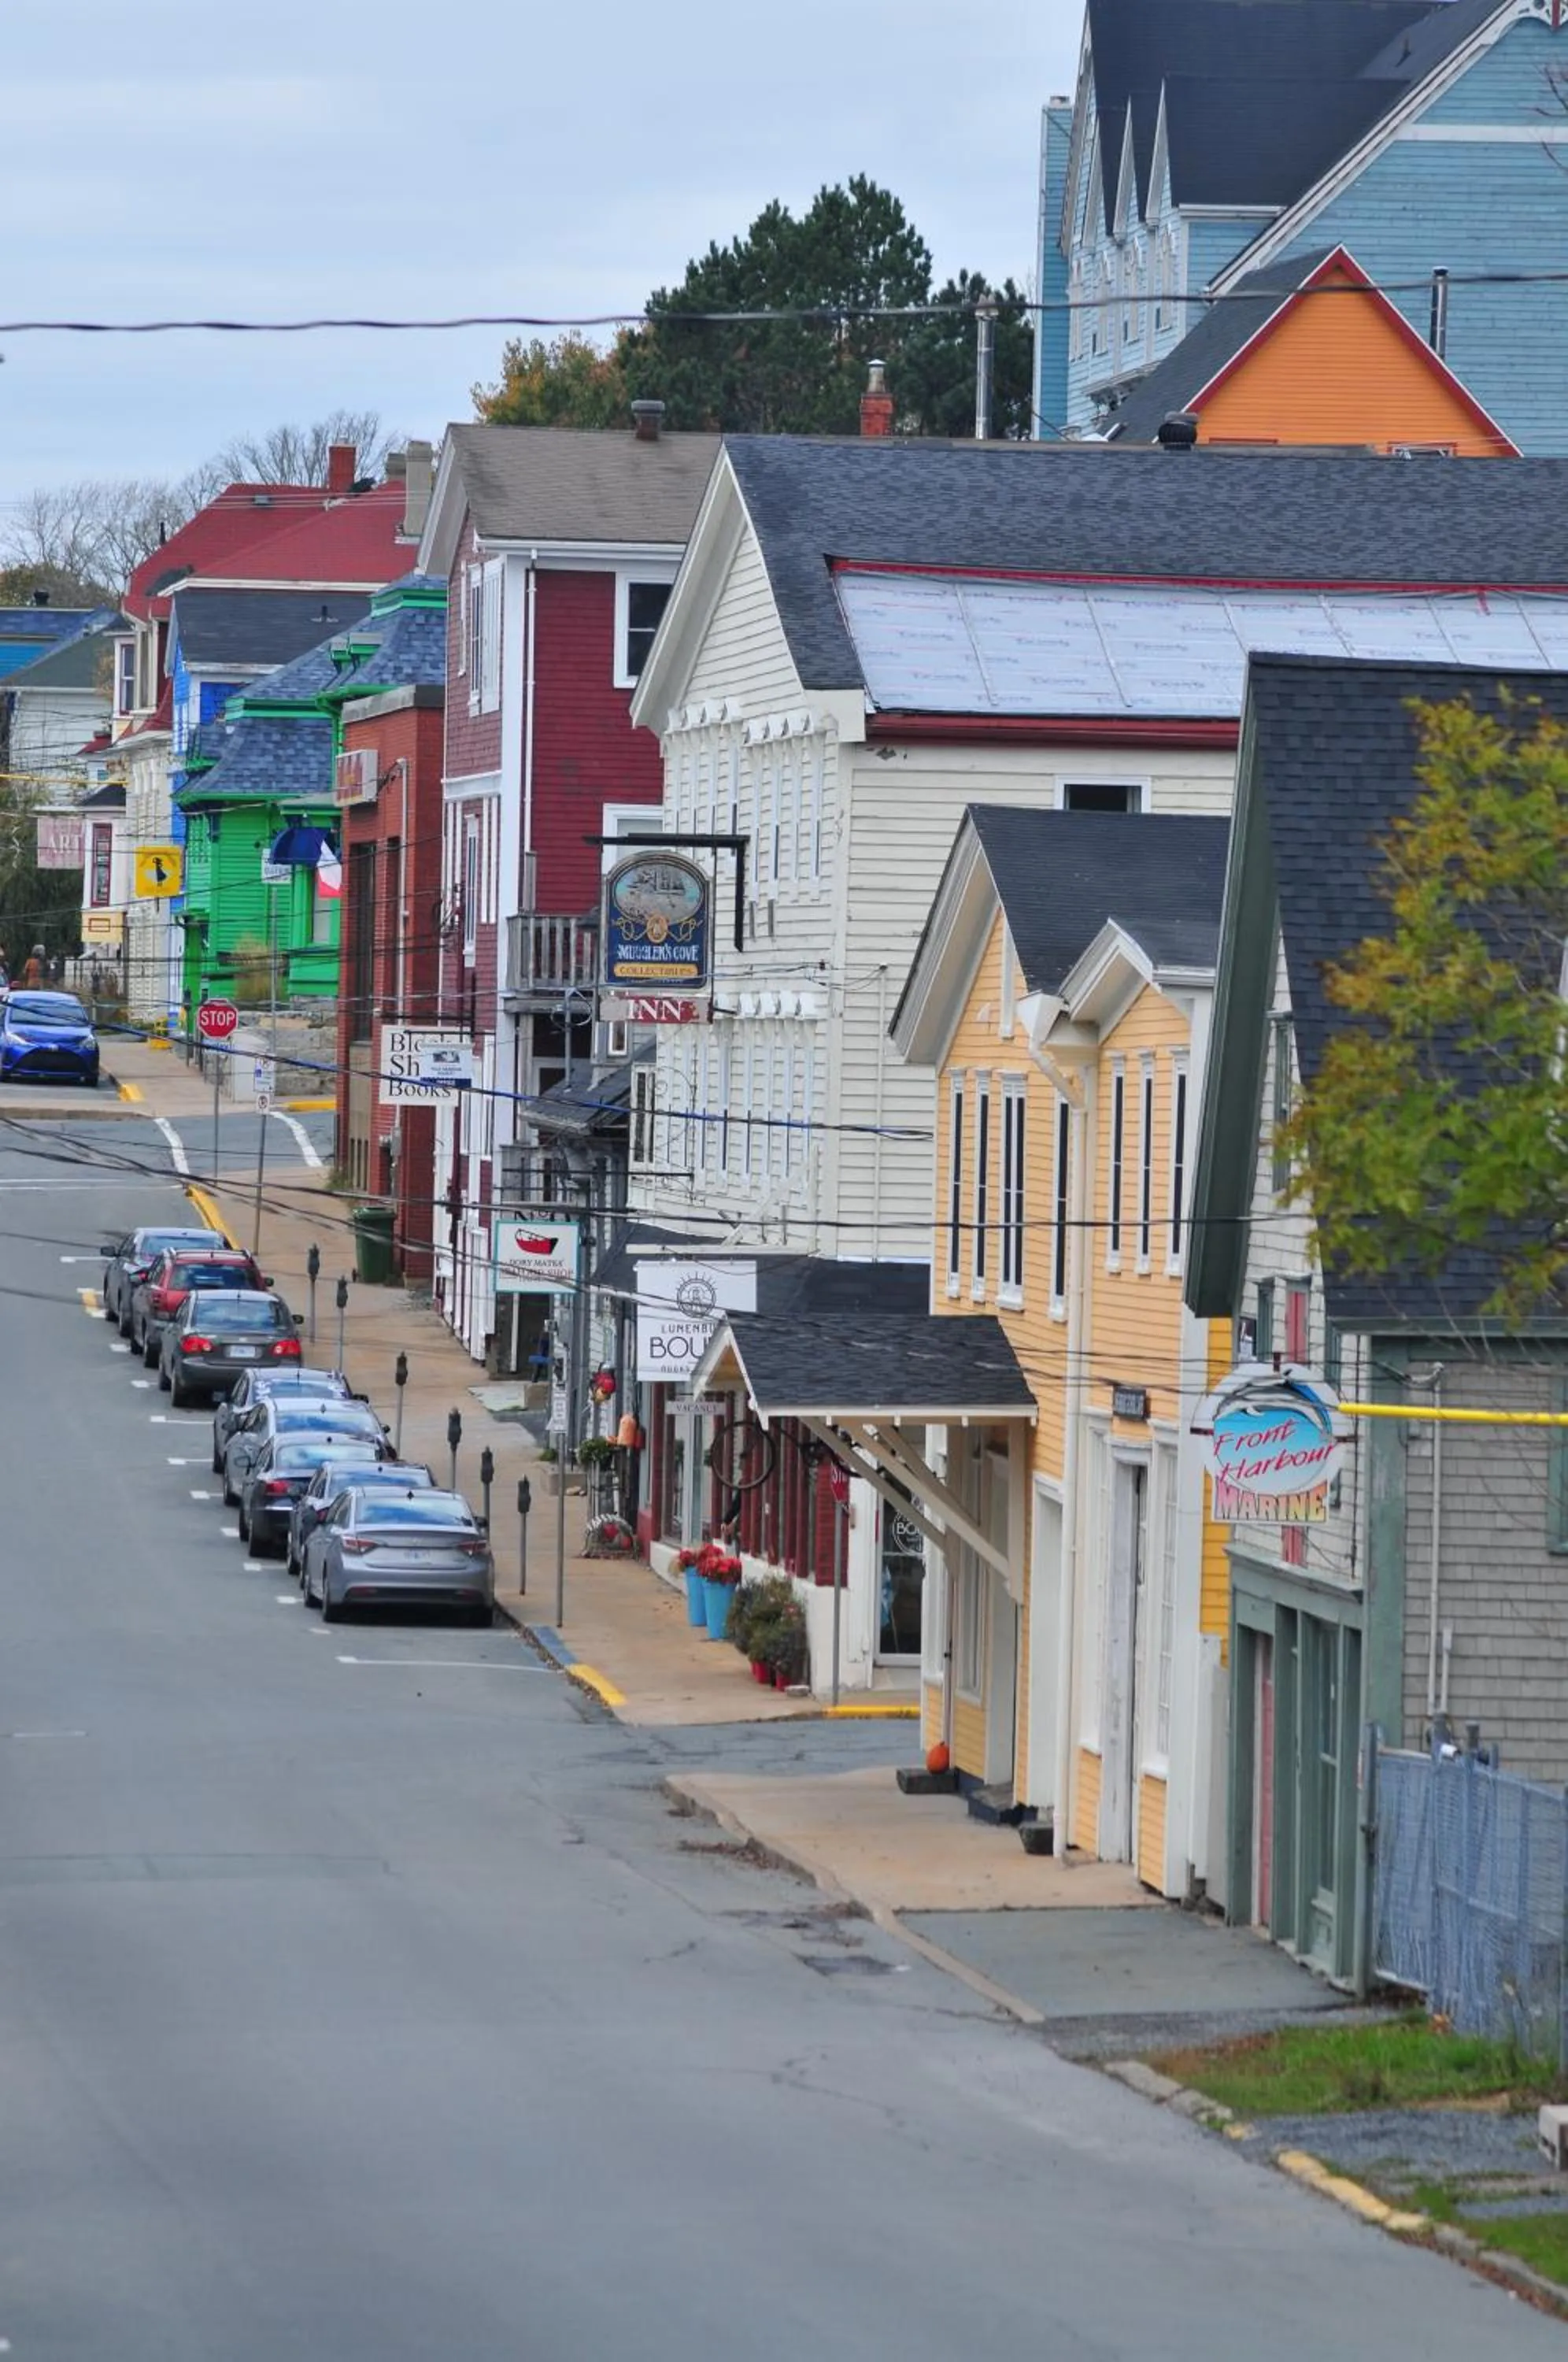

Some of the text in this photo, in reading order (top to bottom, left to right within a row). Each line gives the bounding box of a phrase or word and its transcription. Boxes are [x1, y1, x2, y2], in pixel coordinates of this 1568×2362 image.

[616, 943, 699, 961] SMUGGLER'S COVE
[201, 1010, 235, 1026] STOP
[628, 998, 682, 1021] INN
[390, 1054, 420, 1077] Sh
[389, 1079, 452, 1098] Books
[661, 1323, 716, 1334] LUNENBU
[649, 1336, 711, 1358] BOU
[1214, 1419, 1298, 1456] Front
[1215, 1442, 1335, 1483] Harbour
[1215, 1479, 1327, 1523] MARINE
